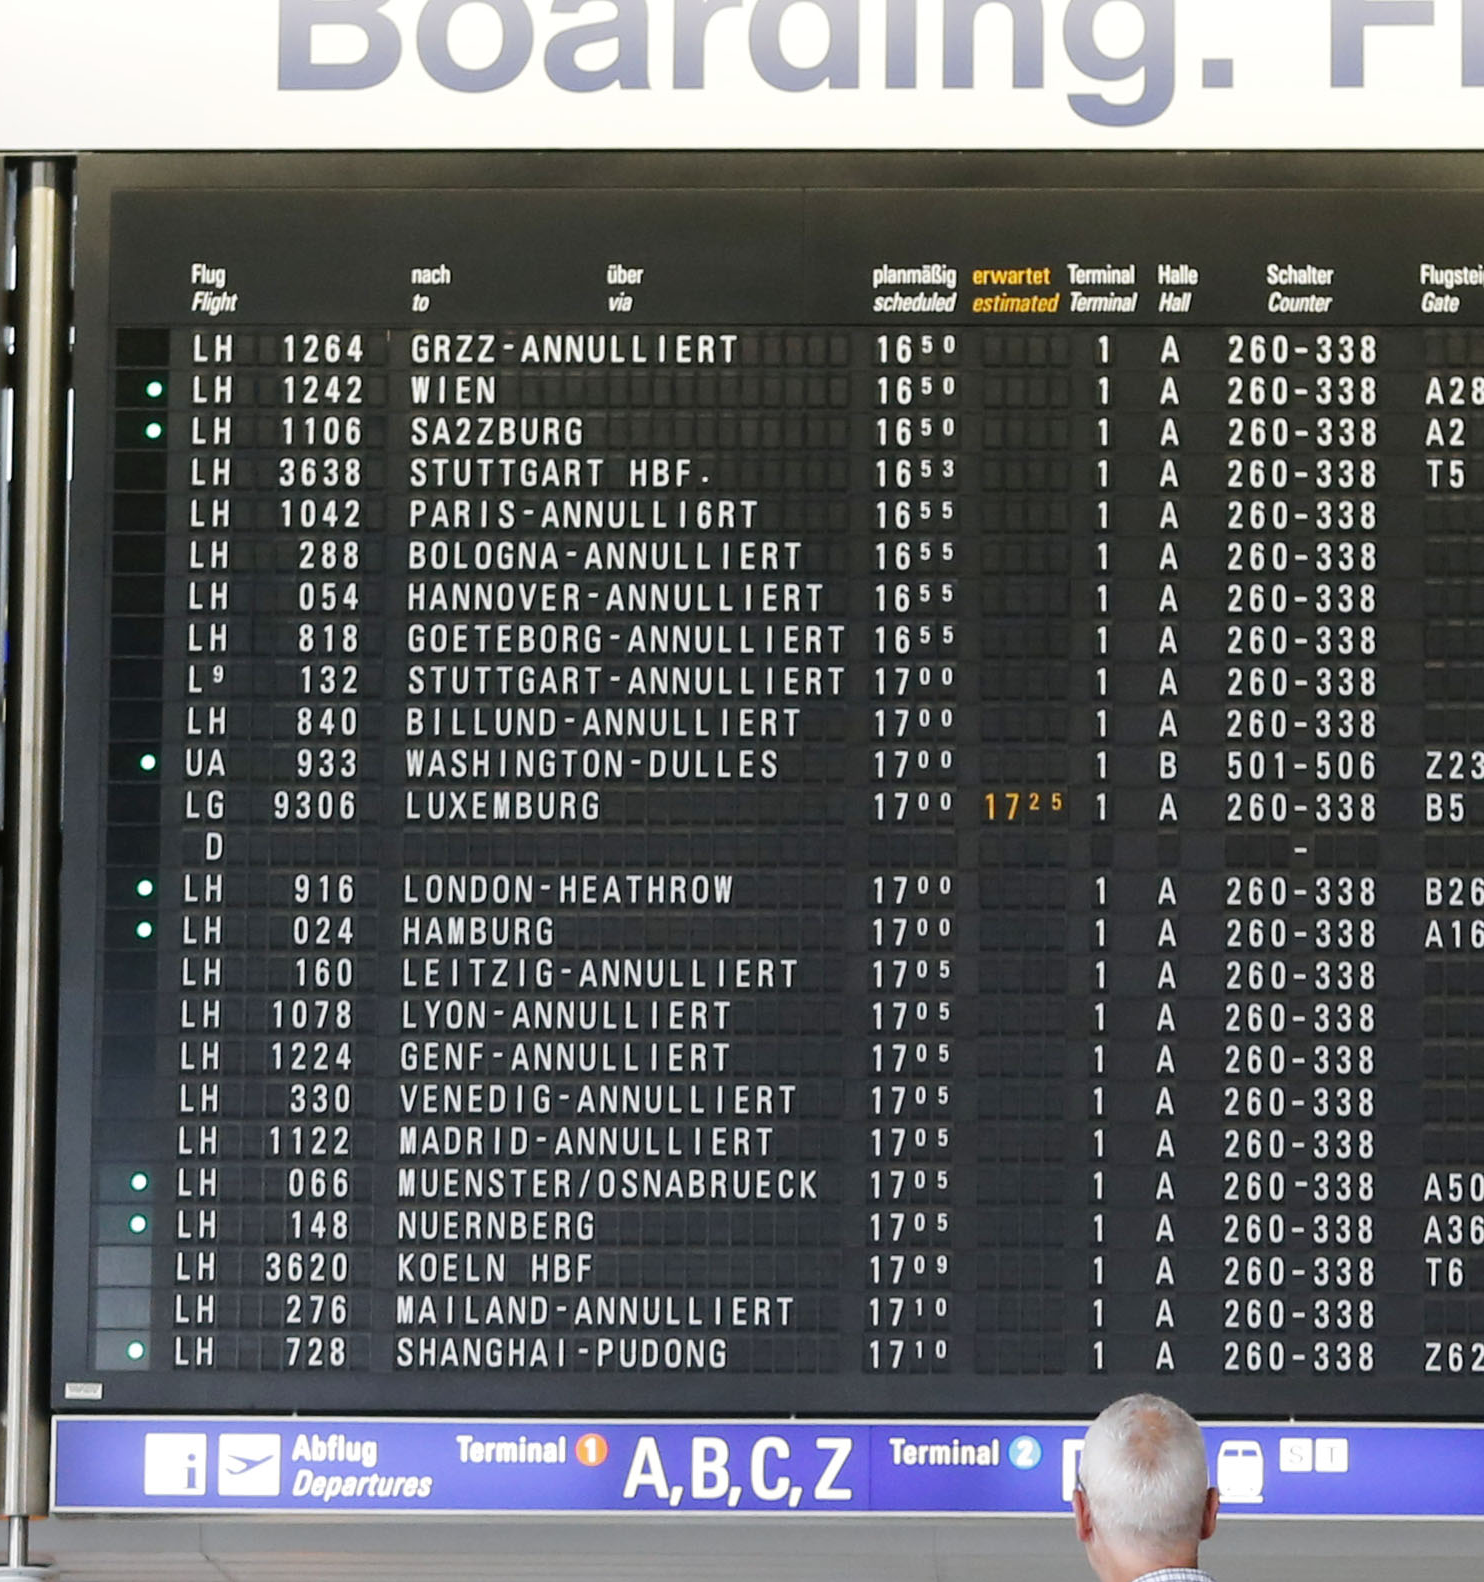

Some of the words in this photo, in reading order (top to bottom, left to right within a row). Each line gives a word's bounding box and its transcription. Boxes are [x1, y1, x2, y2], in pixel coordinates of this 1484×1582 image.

[277, 0, 1234, 128] Boarding.
[191, 263, 226, 288] Flug
[412, 265, 451, 284] nach
[607, 264, 644, 284] über
[873, 265, 956, 289] planmäßig
[972, 266, 1051, 286] erwartet
[1067, 265, 1135, 286] Terminal
[1159, 265, 1198, 286] Halle
[1266, 264, 1334, 286] Schalter
[191, 291, 238, 315] Flight
[412, 293, 430, 312] to
[608, 292, 633, 312] via
[873, 292, 956, 313] scheduled
[972, 292, 1059, 313] estimated
[1069, 292, 1138, 313] Terminal
[1159, 292, 1191, 313] Hall
[1268, 293, 1332, 313] Counter
[1422, 293, 1460, 313] Gate
[411, 334, 738, 364] GRZZ-ANNULLIERT
[410, 375, 495, 404] WIEN
[409, 540, 802, 571] BOLOGNA-ANNULLIERT
[408, 582, 824, 612] HANNOVER-ANNULLIERT
[186, 748, 226, 777] UA
[297, 748, 356, 778] 933
[406, 748, 777, 779] WASHINGTON-DULLES
[1227, 750, 1375, 780] 501-506
[406, 790, 599, 820] LUXEMBURG
[404, 874, 733, 904] LONDON-HEATHROW
[403, 916, 553, 946] HAMBURG
[399, 1126, 773, 1156] MADRID-ANNULLIERT
[398, 1168, 817, 1199] MUENSTER/OSNABRUECK
[178, 1209, 216, 1239] LH
[291, 1210, 348, 1240] 148
[398, 1210, 594, 1241] NUERNBERG
[1224, 1213, 1373, 1244] 260-338
[1423, 1214, 1484, 1245] A36
[398, 1252, 505, 1282] KOELN
[531, 1253, 592, 1283] HBF
[396, 1337, 726, 1369] SHANGHAI-PUDONG
[292, 1434, 377, 1466] Abflug
[457, 1436, 565, 1462] Terminal
[584, 1438, 597, 1463] 1
[890, 1439, 998, 1464] Terminal
[1015, 1440, 1034, 1465] 2
[293, 1470, 432, 1500] Departures
